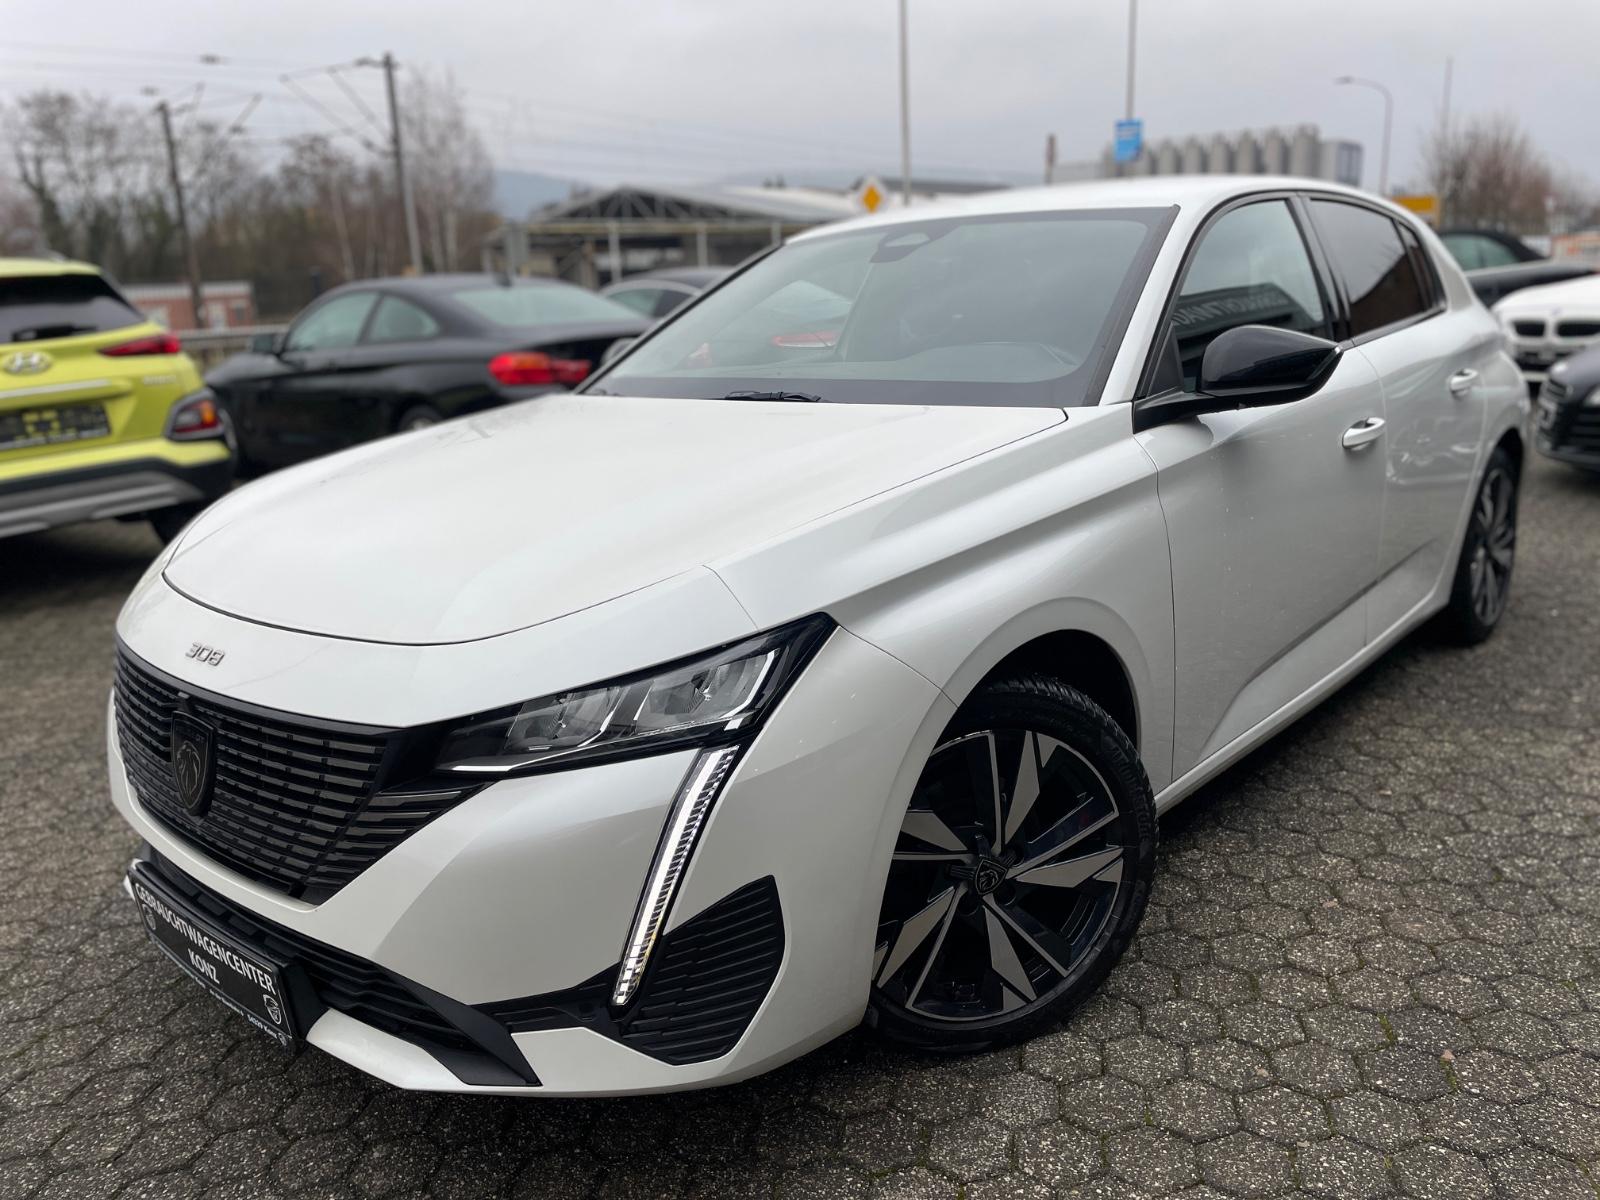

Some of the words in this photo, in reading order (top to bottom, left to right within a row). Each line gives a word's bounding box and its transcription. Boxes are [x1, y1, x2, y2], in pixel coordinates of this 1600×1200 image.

[185, 641, 226, 667] 308
[135, 882, 277, 996] GEBRAUCHTWAGENCENTER
[187, 948, 220, 984] KONZ
